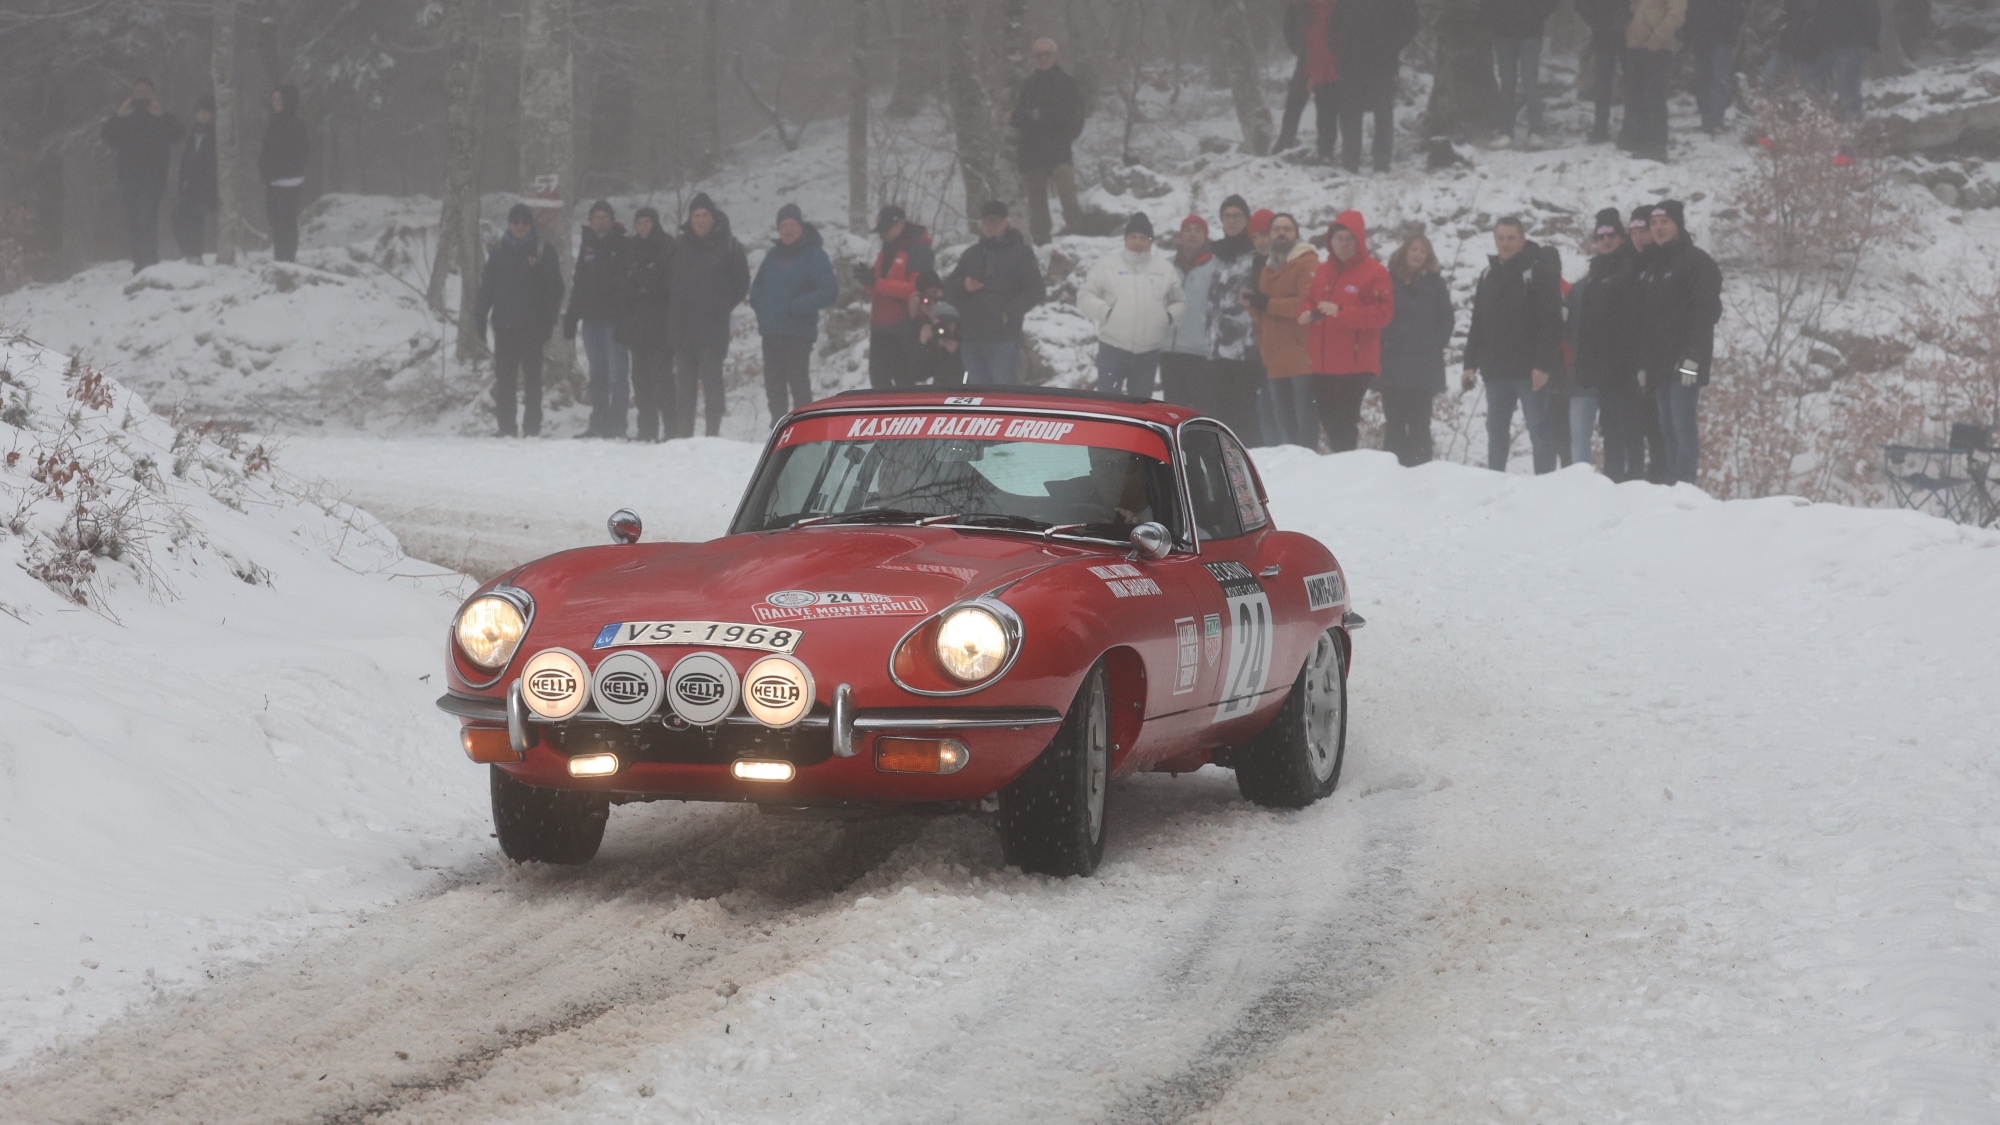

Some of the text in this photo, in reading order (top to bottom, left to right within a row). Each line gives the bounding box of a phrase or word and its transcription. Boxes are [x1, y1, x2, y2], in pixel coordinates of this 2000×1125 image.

[952, 396, 975, 405] 24
[846, 416, 1074, 441] KASHIN RACING GROUP
[1213, 561, 1253, 580] CASINO
[826, 593, 853, 603] 24
[1225, 583, 1261, 599] MONTE-CARLO
[758, 600, 923, 621] RALLYE MONTE-CARLO
[803, 610, 886, 620] HISTORIQUE
[1206, 620, 1220, 636] TAG
[598, 635, 613, 644] LV
[1224, 602, 1266, 713] 24
[532, 678, 577, 693] HELLA
[603, 681, 649, 697] HELLA
[679, 682, 725, 699] HELLA
[754, 685, 800, 701] HELLA
